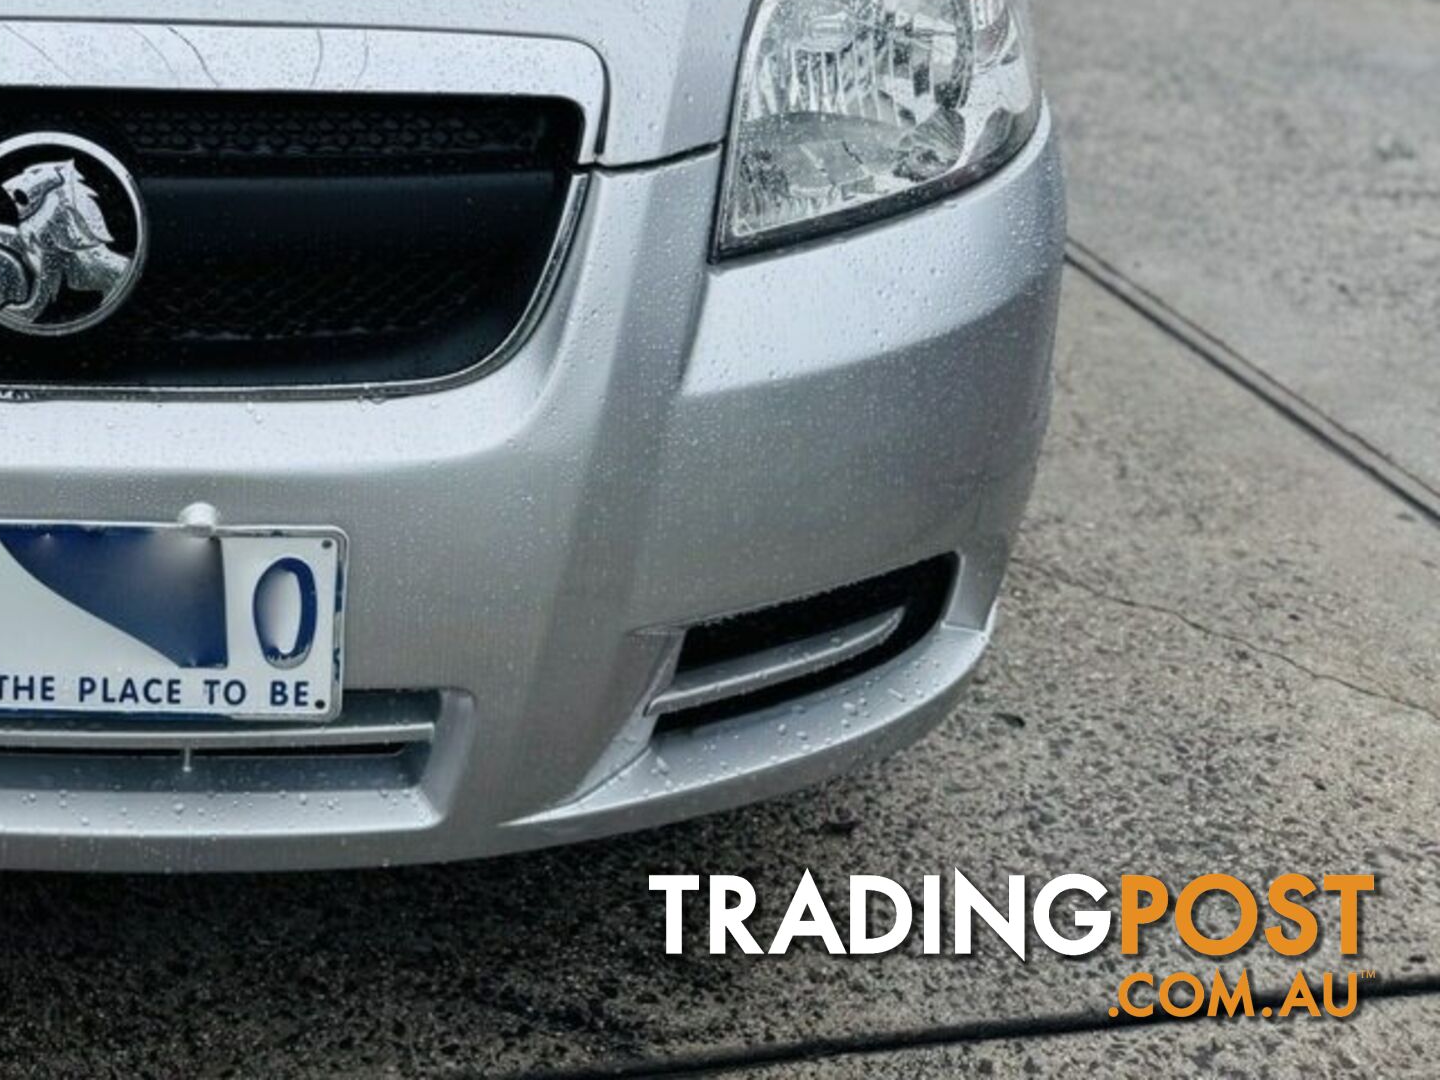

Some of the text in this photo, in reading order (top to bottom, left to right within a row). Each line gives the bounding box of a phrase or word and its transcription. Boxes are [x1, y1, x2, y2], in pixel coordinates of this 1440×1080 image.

[77, 675, 182, 706] PLACE
[202, 678, 248, 707] TO
[268, 679, 310, 708] BE
